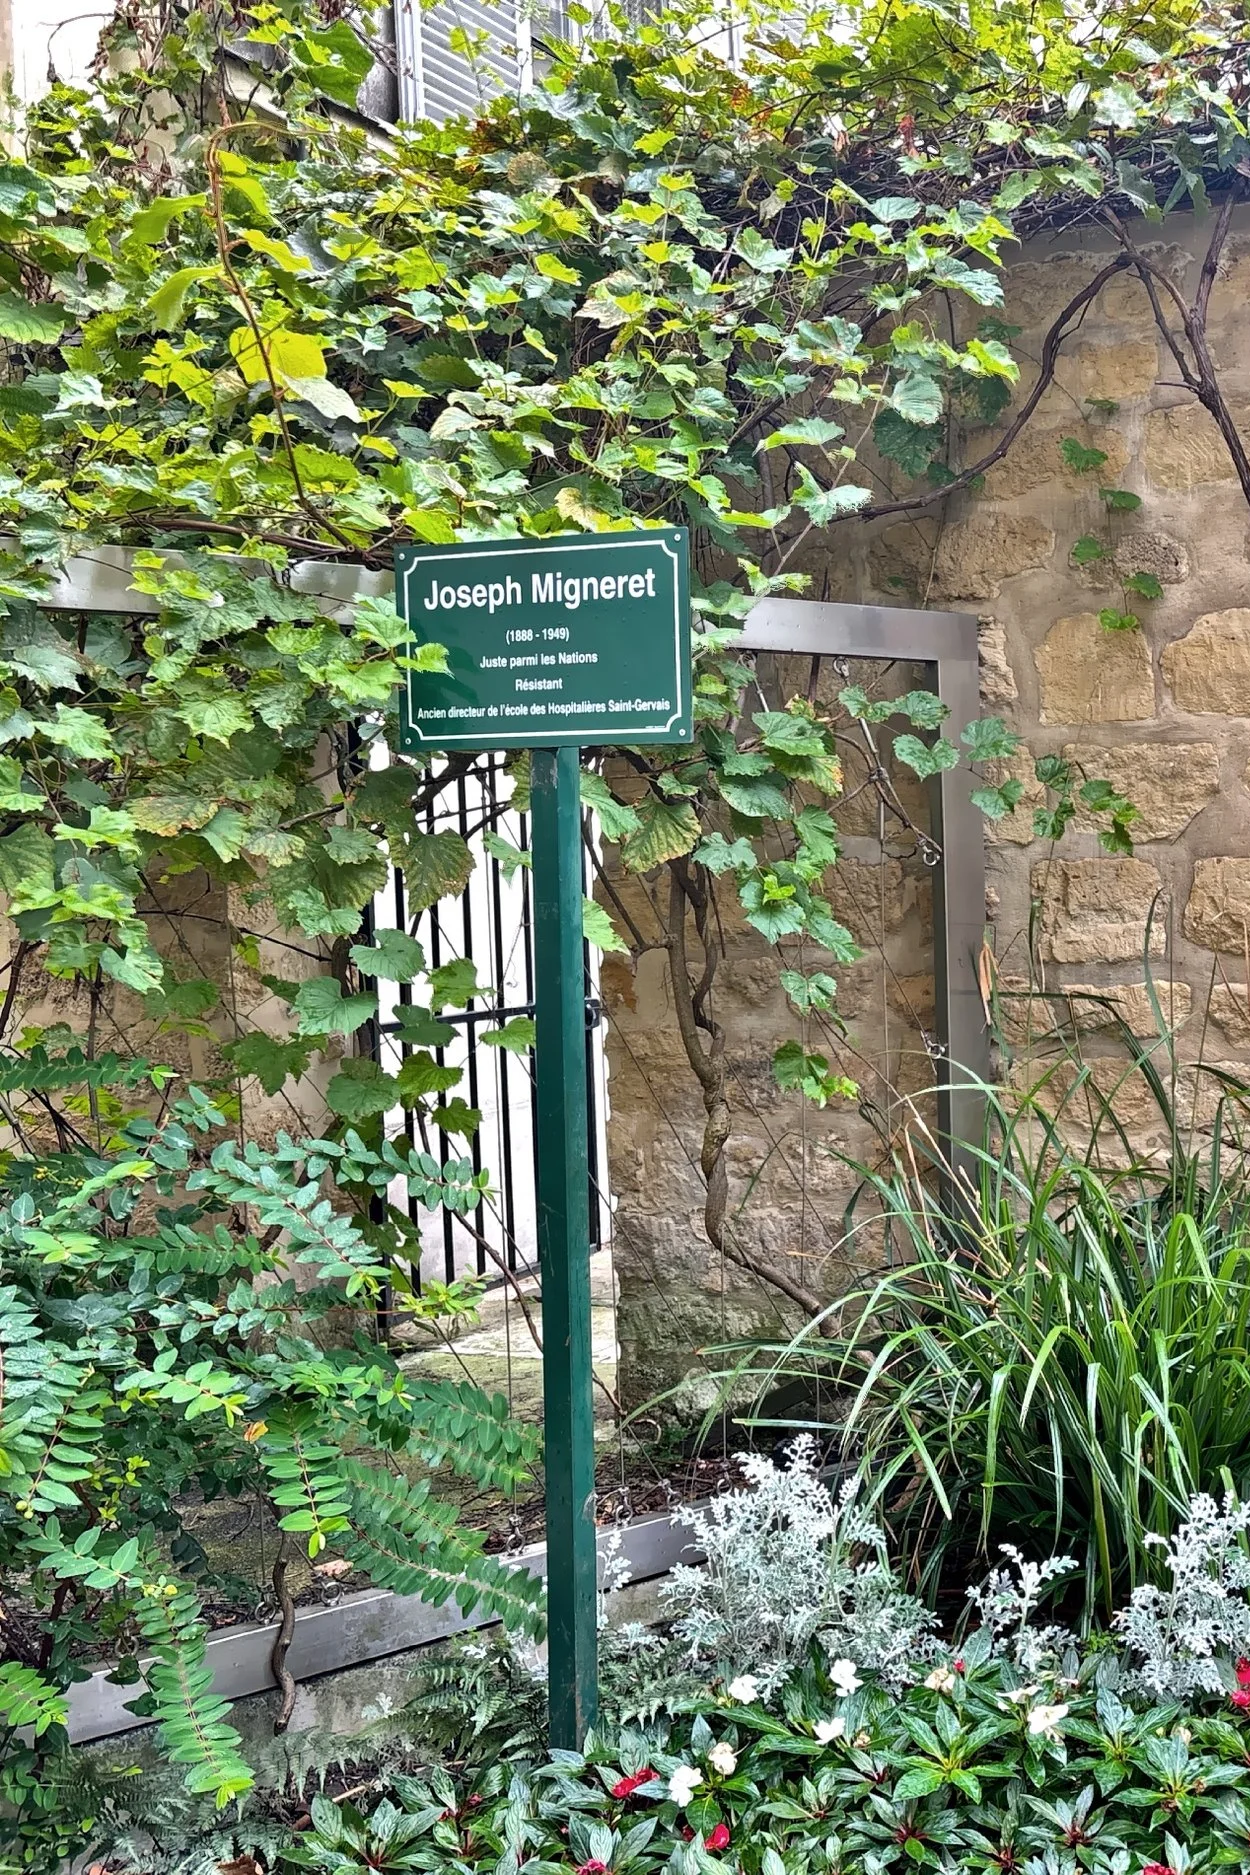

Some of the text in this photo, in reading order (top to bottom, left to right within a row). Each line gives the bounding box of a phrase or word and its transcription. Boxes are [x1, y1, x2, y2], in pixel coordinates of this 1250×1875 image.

[424, 569, 655, 613] Joseph Migneret
[506, 629, 533, 644] (1888
[542, 627, 569, 641] 1949)
[480, 652, 597, 669] Juste parmi les Nations
[516, 678, 562, 691] Résistant
[418, 698, 670, 719] Ancien directeur de l'école des Hospitalières Saint-Gervais
